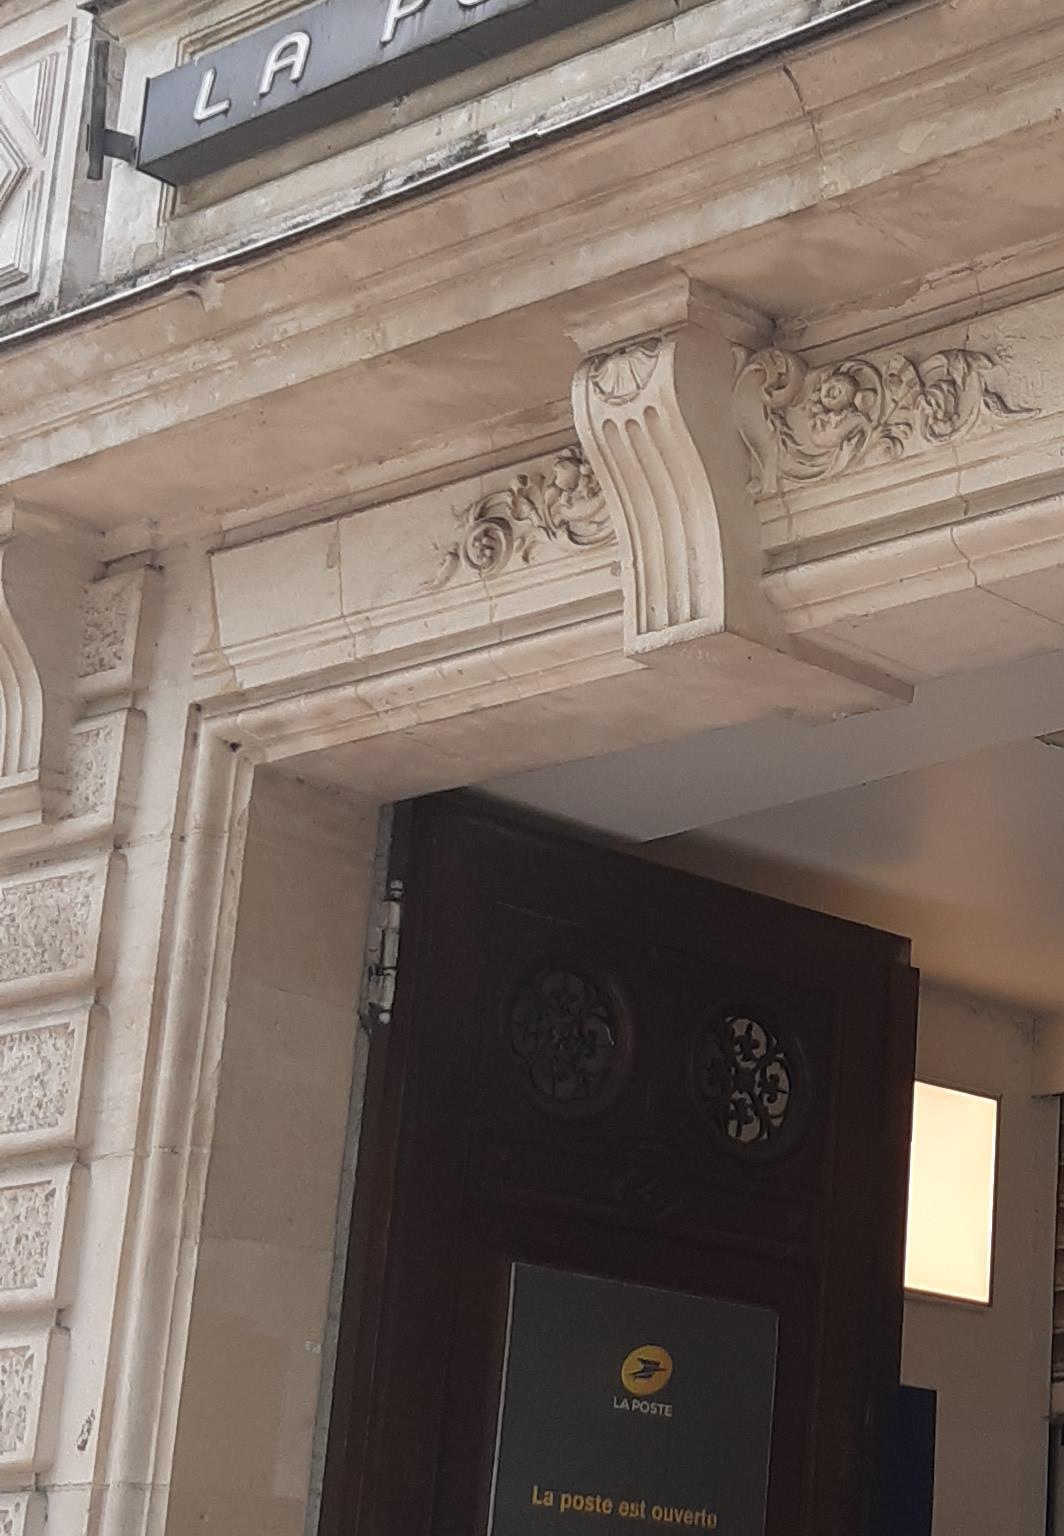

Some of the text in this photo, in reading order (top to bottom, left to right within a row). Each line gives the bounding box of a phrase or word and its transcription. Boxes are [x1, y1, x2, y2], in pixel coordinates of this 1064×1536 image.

[192, 32, 311, 121] LA
[613, 1396, 673, 1417] LA POSTE
[531, 1484, 554, 1507] La
[559, 1490, 613, 1515] poste
[618, 1500, 646, 1518] est
